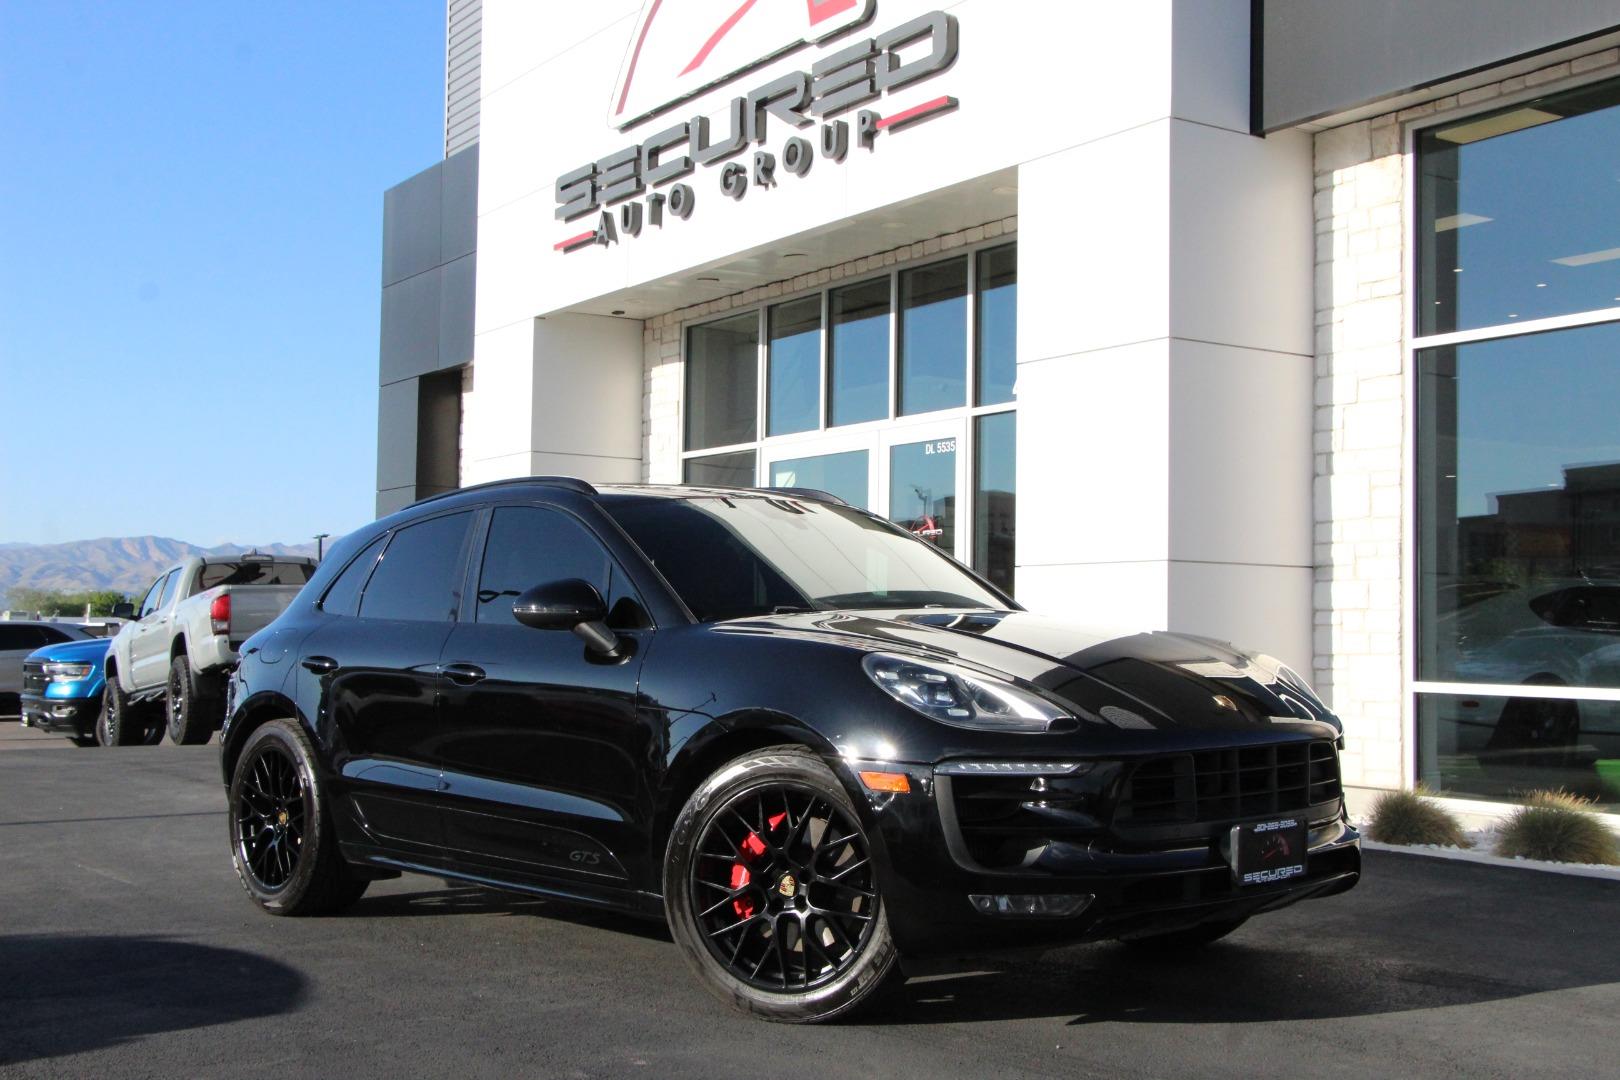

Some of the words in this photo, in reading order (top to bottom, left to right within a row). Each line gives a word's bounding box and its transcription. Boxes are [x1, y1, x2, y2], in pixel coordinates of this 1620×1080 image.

[555, 10, 959, 221] SECURED
[595, 183, 695, 247] AUTO
[720, 109, 882, 200] GROUP
[925, 443, 935, 454] DL
[936, 441, 956, 453] 5535
[569, 850, 601, 864] GTS
[1243, 865, 1303, 882] SECURED
